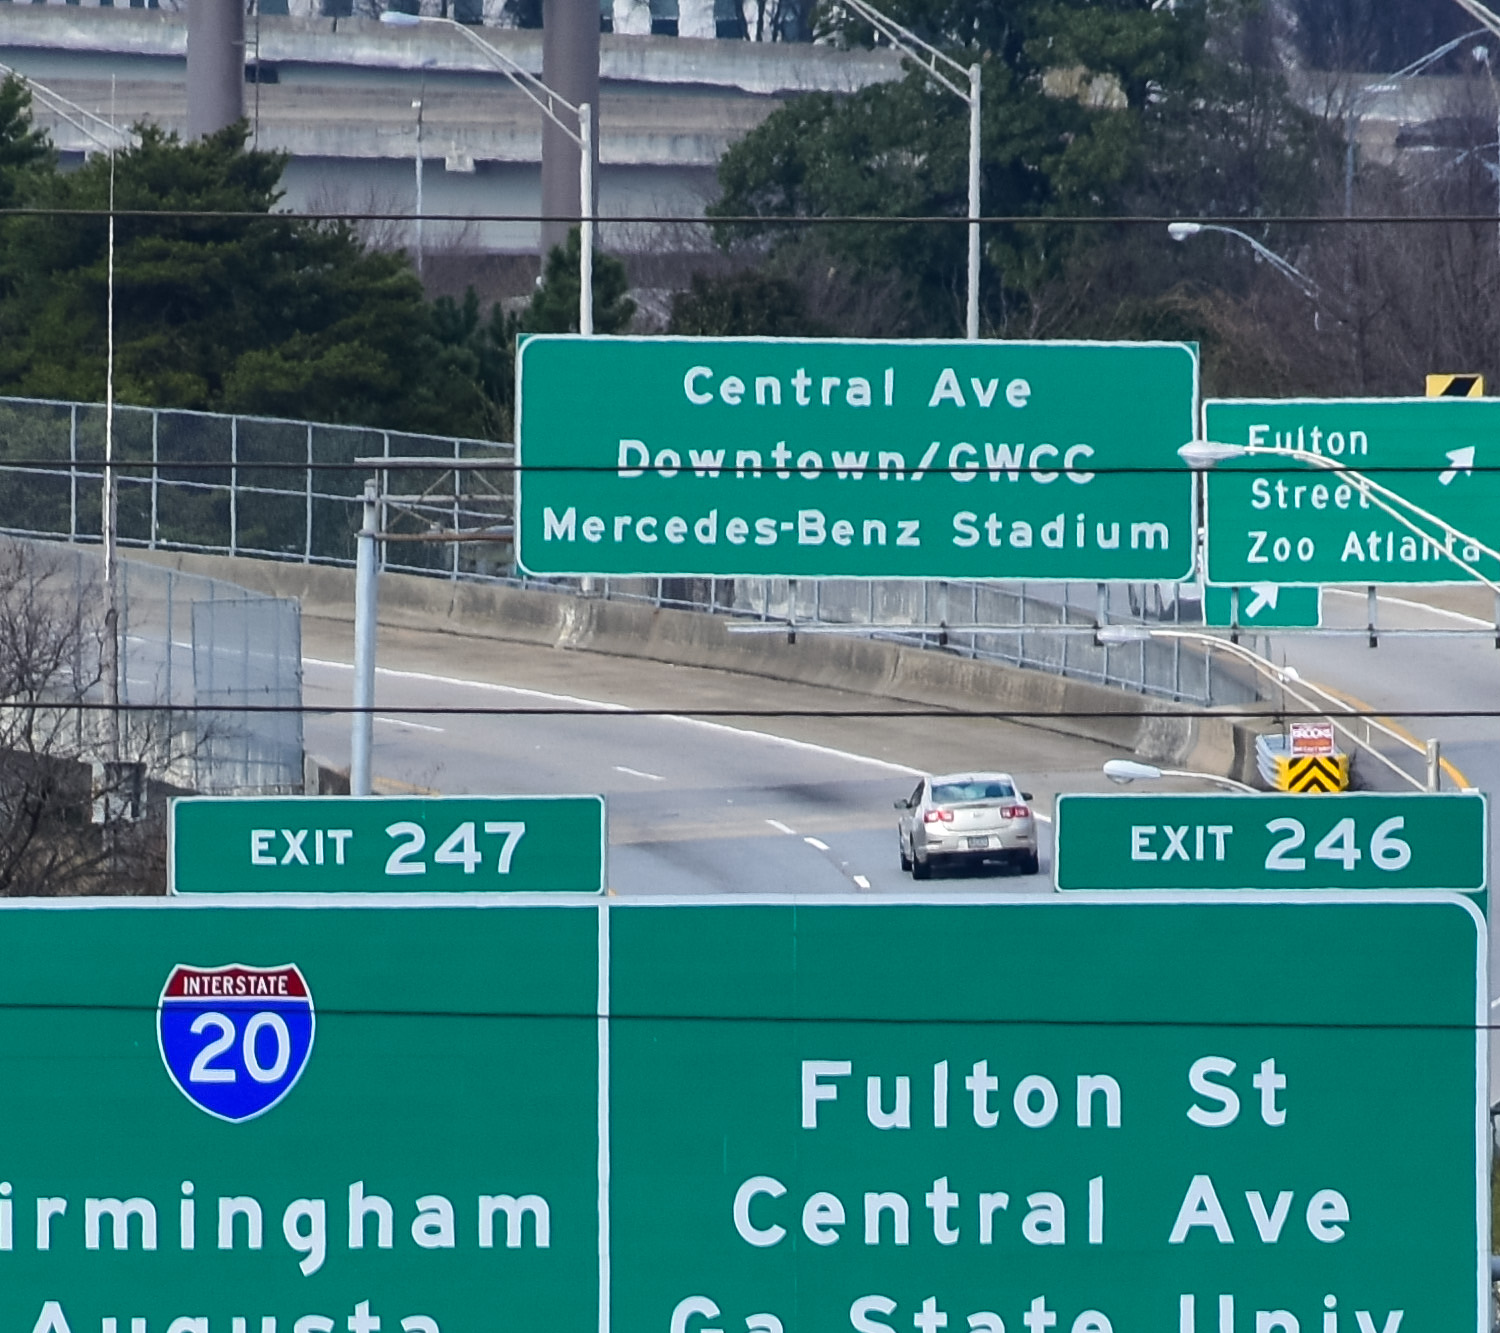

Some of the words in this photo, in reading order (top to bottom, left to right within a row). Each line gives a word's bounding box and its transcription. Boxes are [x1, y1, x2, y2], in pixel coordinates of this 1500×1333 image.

[683, 365, 895, 408] Central
[928, 367, 1033, 408] Ave
[616, 438, 1098, 485] Downtown/GWCC
[1248, 424, 1370, 456] Fulton
[1250, 477, 1371, 510] Street
[542, 505, 922, 548] Mercedes-Benz
[952, 509, 1172, 551] Stadium
[1246, 530, 1316, 564] Zoo
[249, 827, 354, 867] EXIT
[383, 820, 528, 877] 247
[1129, 825, 1235, 863] EXIT
[1264, 815, 1414, 873] 246
[183, 975, 290, 997] INTERSTATE
[187, 1011, 292, 1085] 20
[800, 1058, 1124, 1131] Fulton
[1186, 1055, 1289, 1129] St
[731, 1173, 1105, 1247] Central
[1167, 1173, 1353, 1245] Ave
